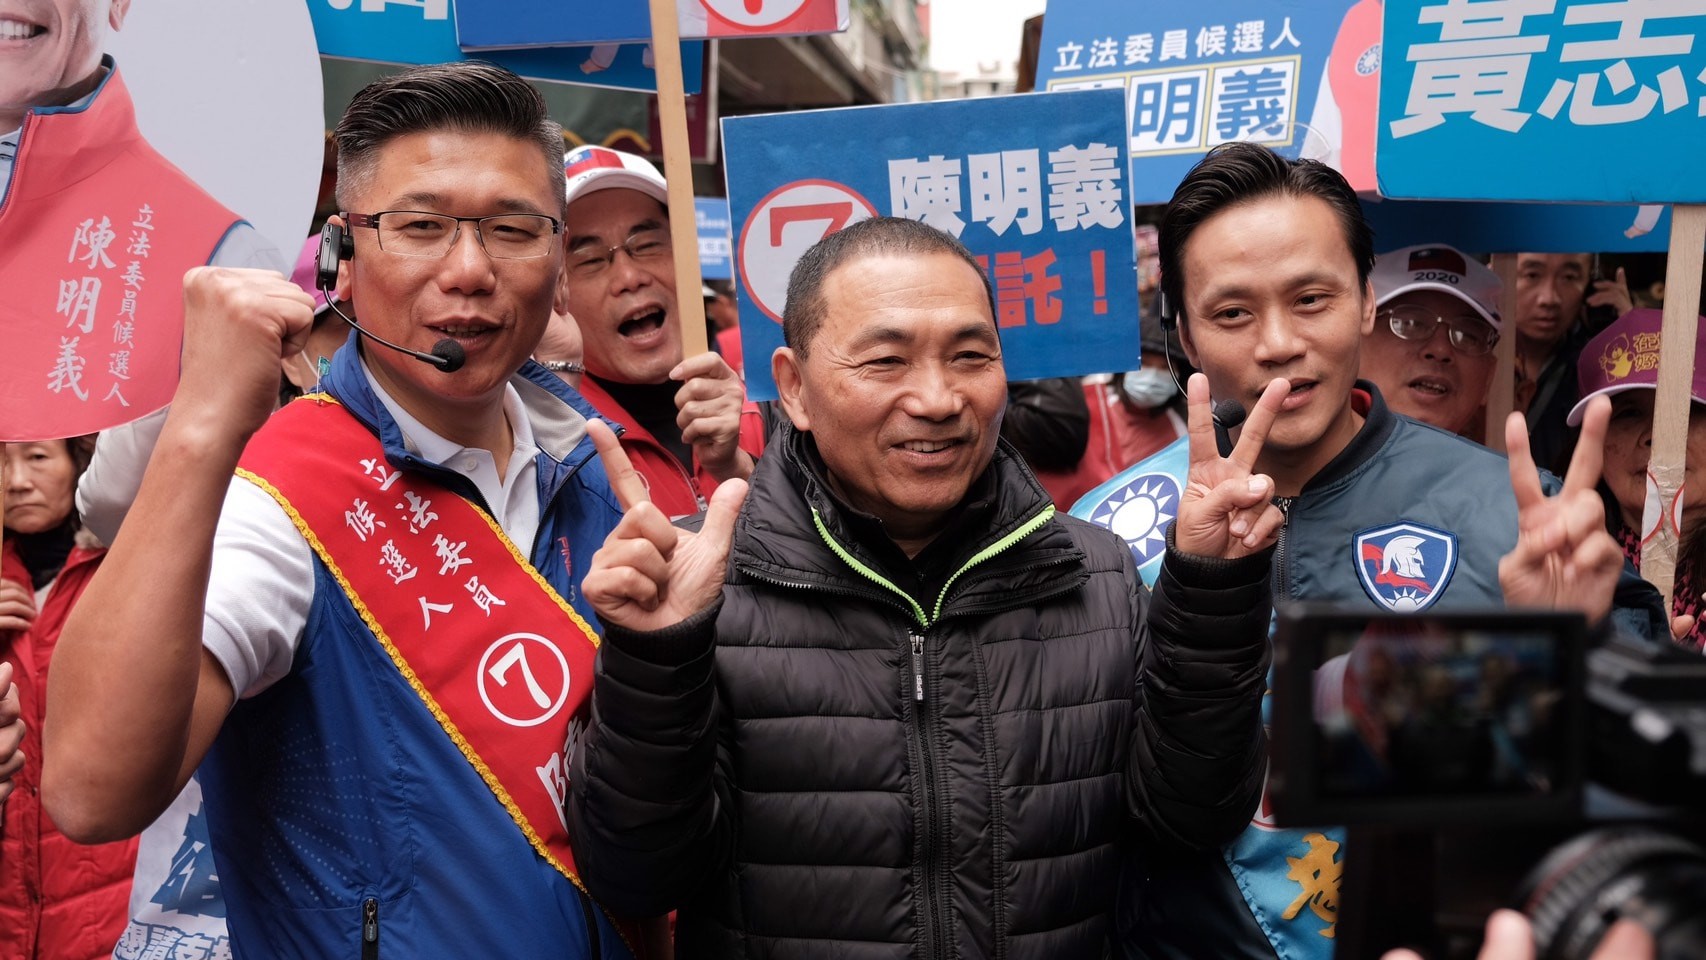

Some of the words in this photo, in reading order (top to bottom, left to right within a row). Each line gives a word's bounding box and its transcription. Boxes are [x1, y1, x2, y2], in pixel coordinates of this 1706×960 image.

[1053, 17, 1301, 72] 立法委員候選人
[1389, 0, 1706, 139] 黃志
[1053, 67, 1287, 146] 明義
[888, 142, 1125, 239] 陳明義
[47, 215, 117, 402] 陳明義
[102, 203, 155, 408] 立法委員候選人
[974, 247, 1108, 328] 託！
[1414, 271, 1460, 285] 2020
[345, 498, 454, 632] 候選人
[359, 458, 506, 617] 立法委員
[488, 641, 552, 710] 7
